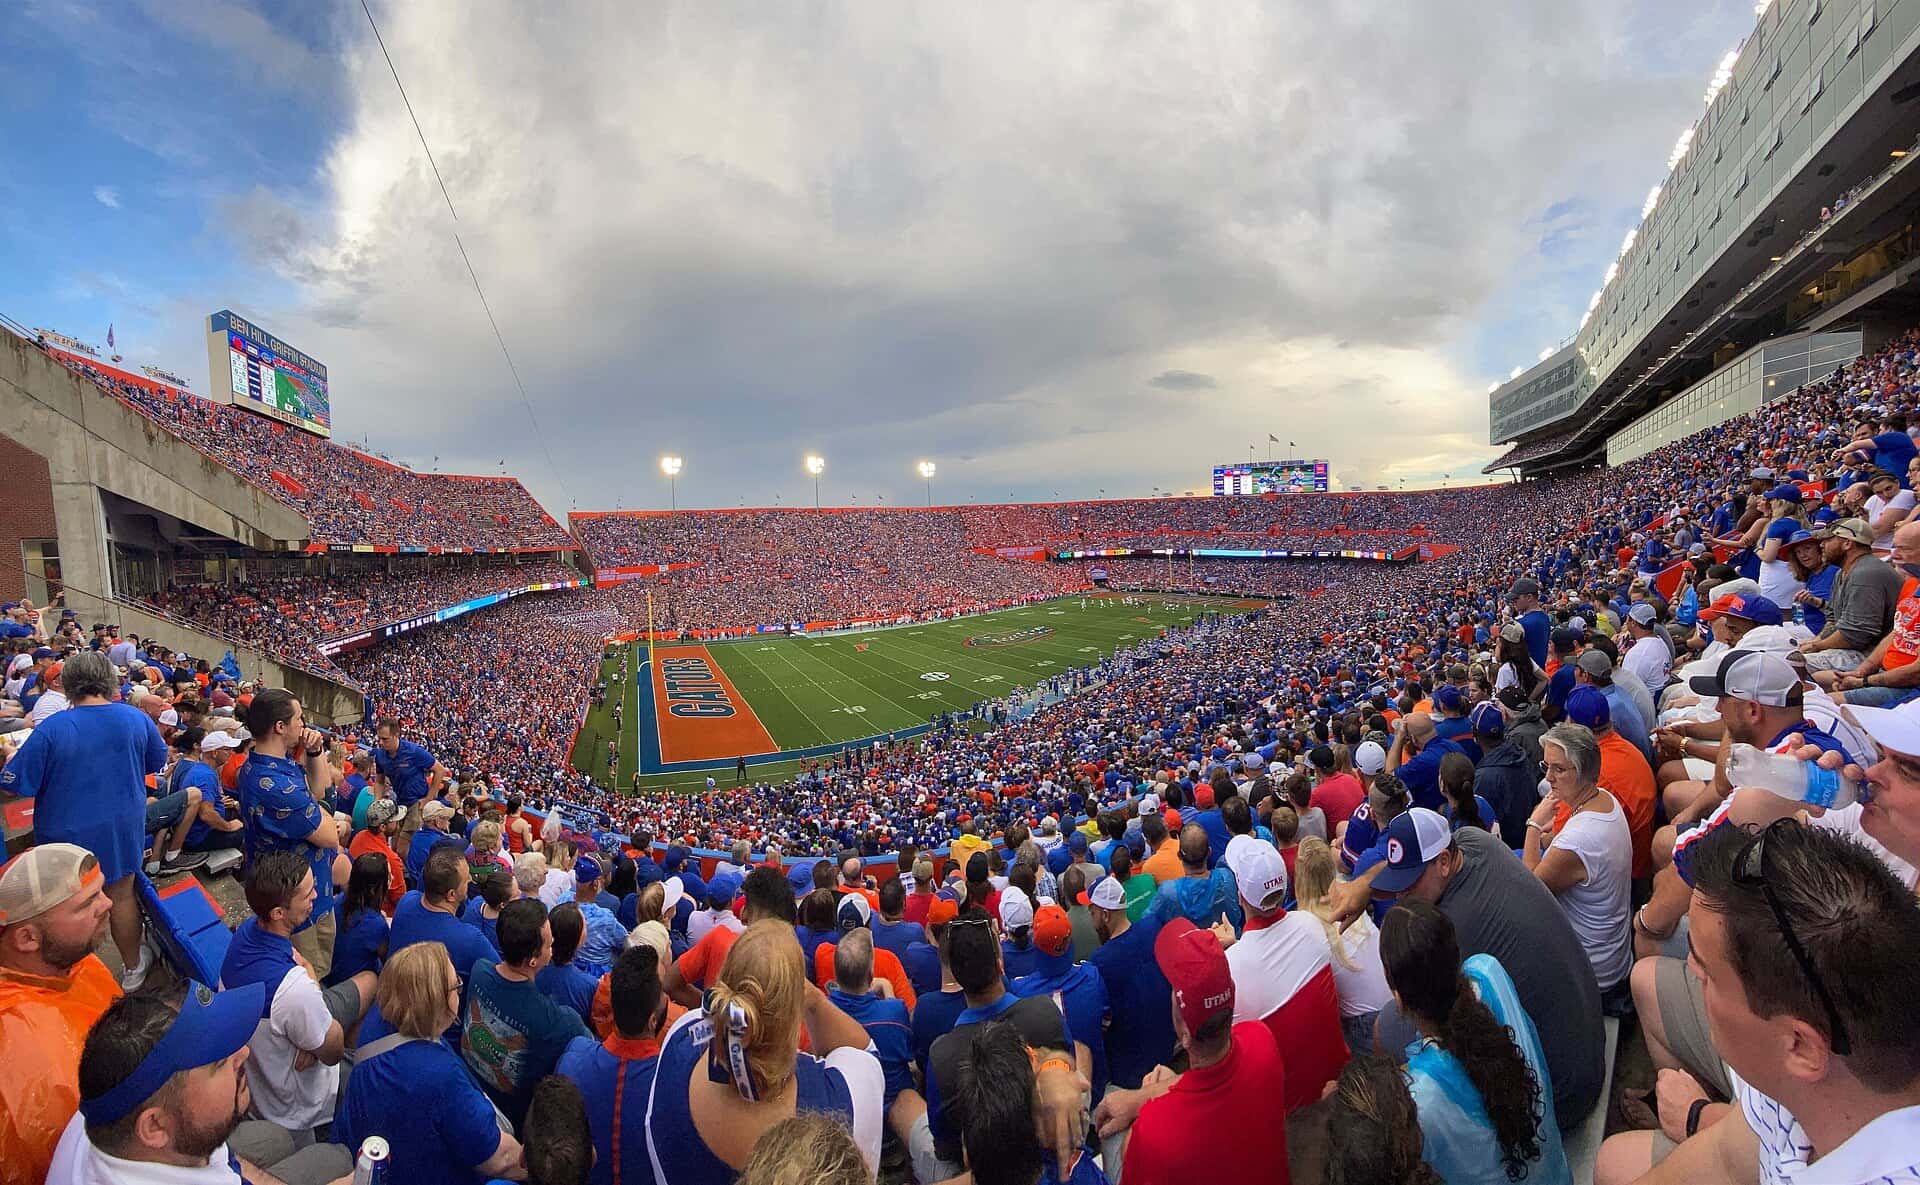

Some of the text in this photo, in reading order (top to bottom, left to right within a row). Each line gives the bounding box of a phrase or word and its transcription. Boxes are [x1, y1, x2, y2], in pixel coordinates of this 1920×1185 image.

[230, 314, 249, 337] BEN
[251, 327, 270, 347] HILL
[270, 338, 299, 363] GRIFFIN
[300, 354, 327, 378] STADIUM
[661, 657, 738, 718] GATORS
[917, 690, 943, 700] 20
[1390, 842, 1398, 859] F
[1263, 875, 1284, 890] UTAH
[1204, 988, 1232, 1009] UTAH
